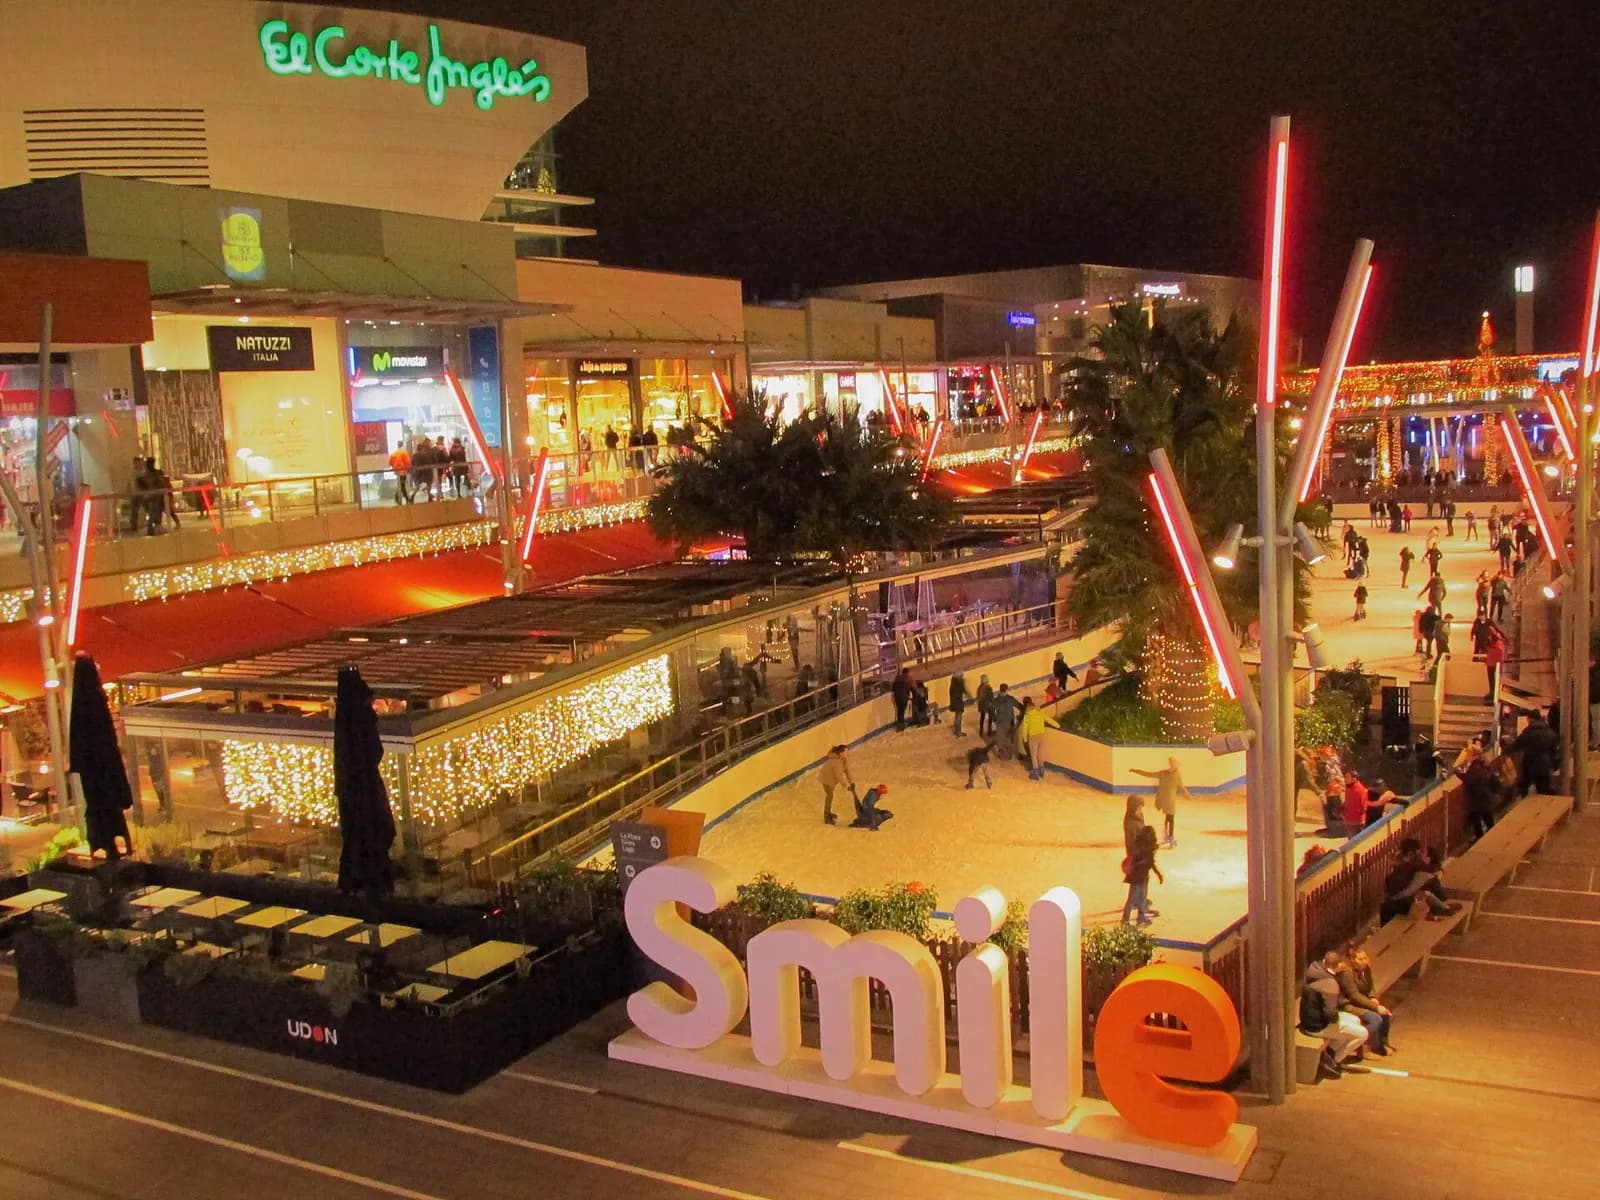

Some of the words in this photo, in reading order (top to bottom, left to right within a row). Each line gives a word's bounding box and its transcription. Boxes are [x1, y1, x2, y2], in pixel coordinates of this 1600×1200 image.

[260, 20, 312, 75] El
[314, 26, 421, 84] Corte
[426, 25, 550, 110] Inglés
[236, 336, 291, 351] NATUZZI
[253, 353, 279, 361] ITALIA
[391, 356, 427, 367] movistar
[625, 856, 1240, 1148] Smile
[287, 1019, 338, 1045] UDON
